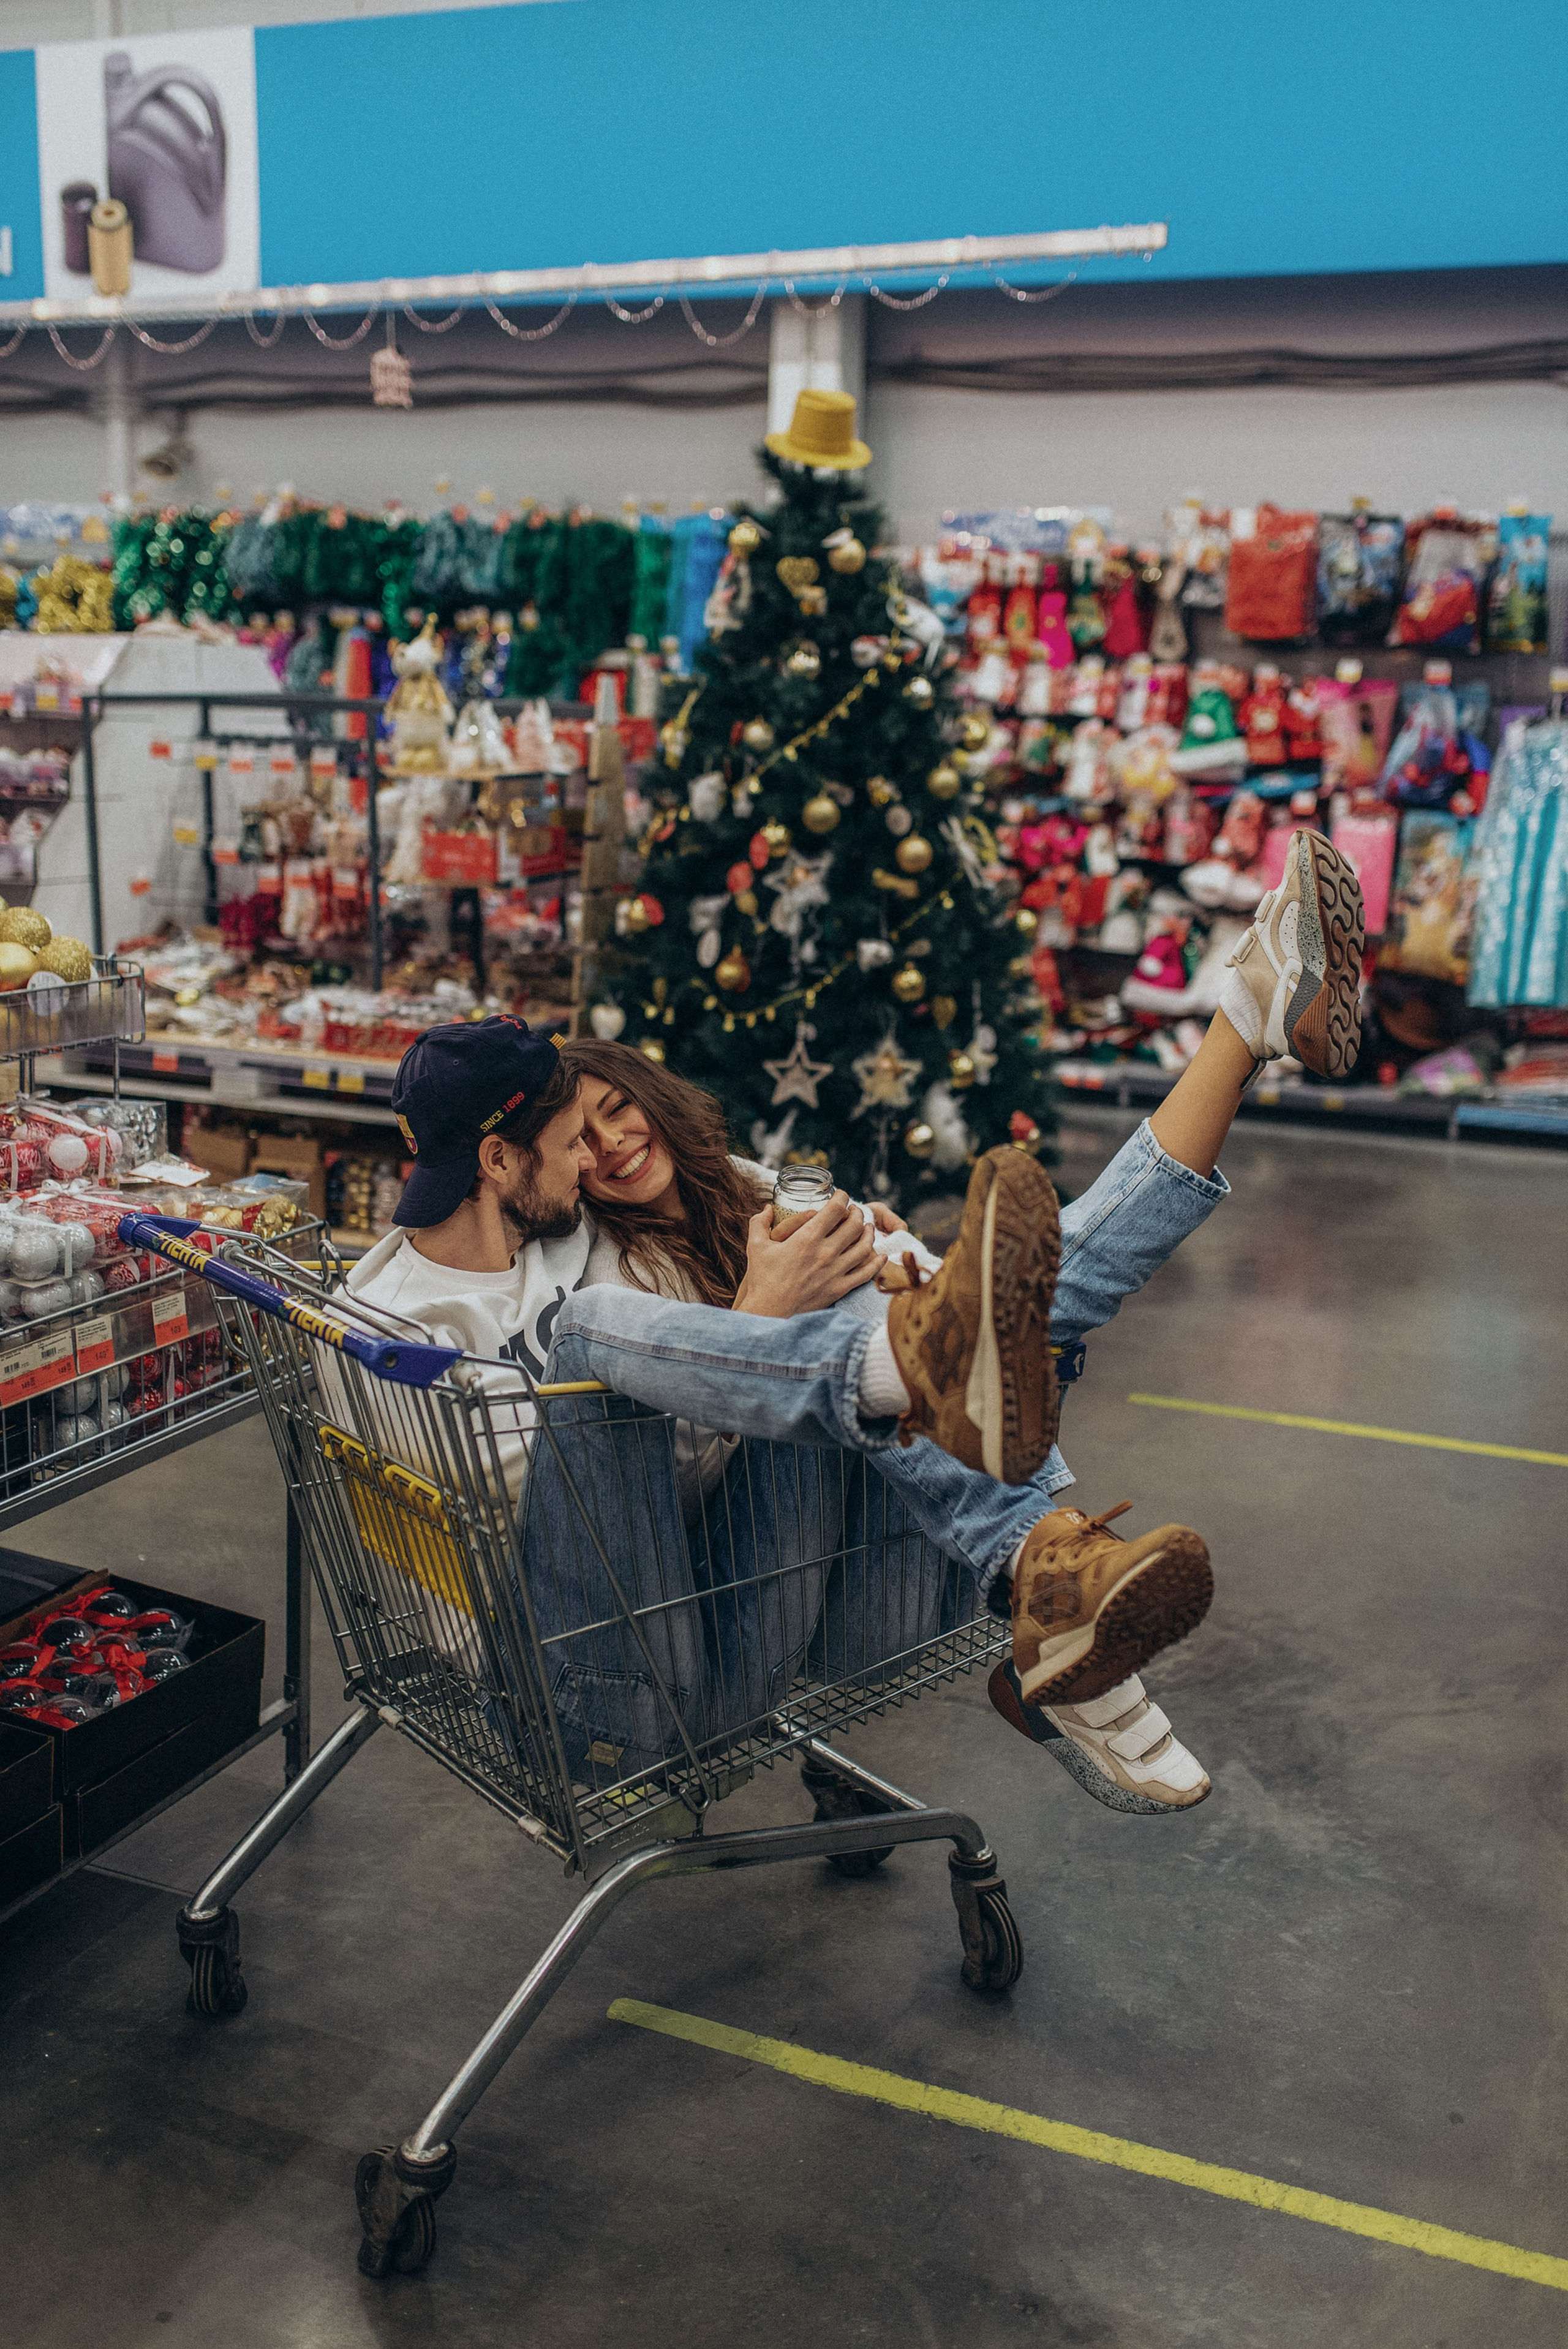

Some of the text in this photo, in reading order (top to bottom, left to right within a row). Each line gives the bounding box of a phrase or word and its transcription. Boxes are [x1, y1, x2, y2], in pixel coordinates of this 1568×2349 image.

[480, 1092, 525, 1133] SINCE 1899
[160, 1234, 214, 1272] ЛЕНТА
[171, 1325, 181, 1335] 169
[289, 1303, 350, 1349] ЛЕНТА
[95, 1350, 107, 1360] 149
